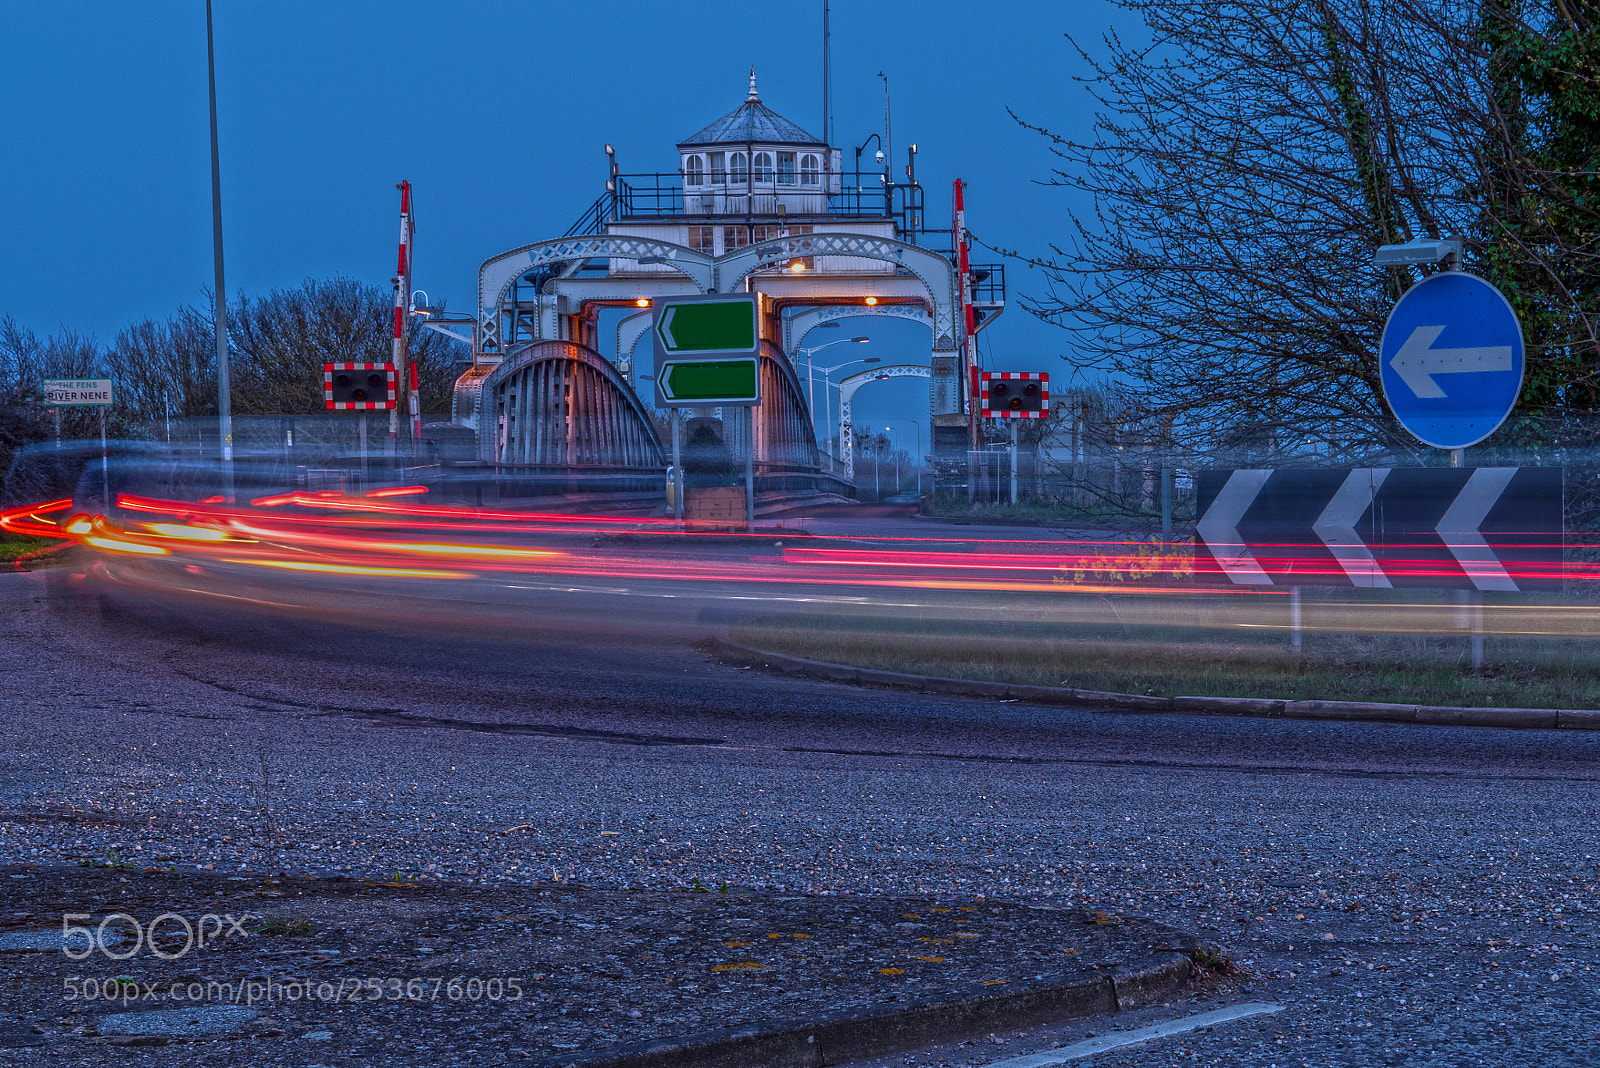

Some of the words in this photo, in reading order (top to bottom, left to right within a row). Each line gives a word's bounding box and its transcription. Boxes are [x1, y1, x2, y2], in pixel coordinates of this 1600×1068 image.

[59, 381, 74, 389] THE
[76, 381, 98, 389] FENS
[48, 391, 78, 400] RIVER
[80, 391, 109, 400] NENE
